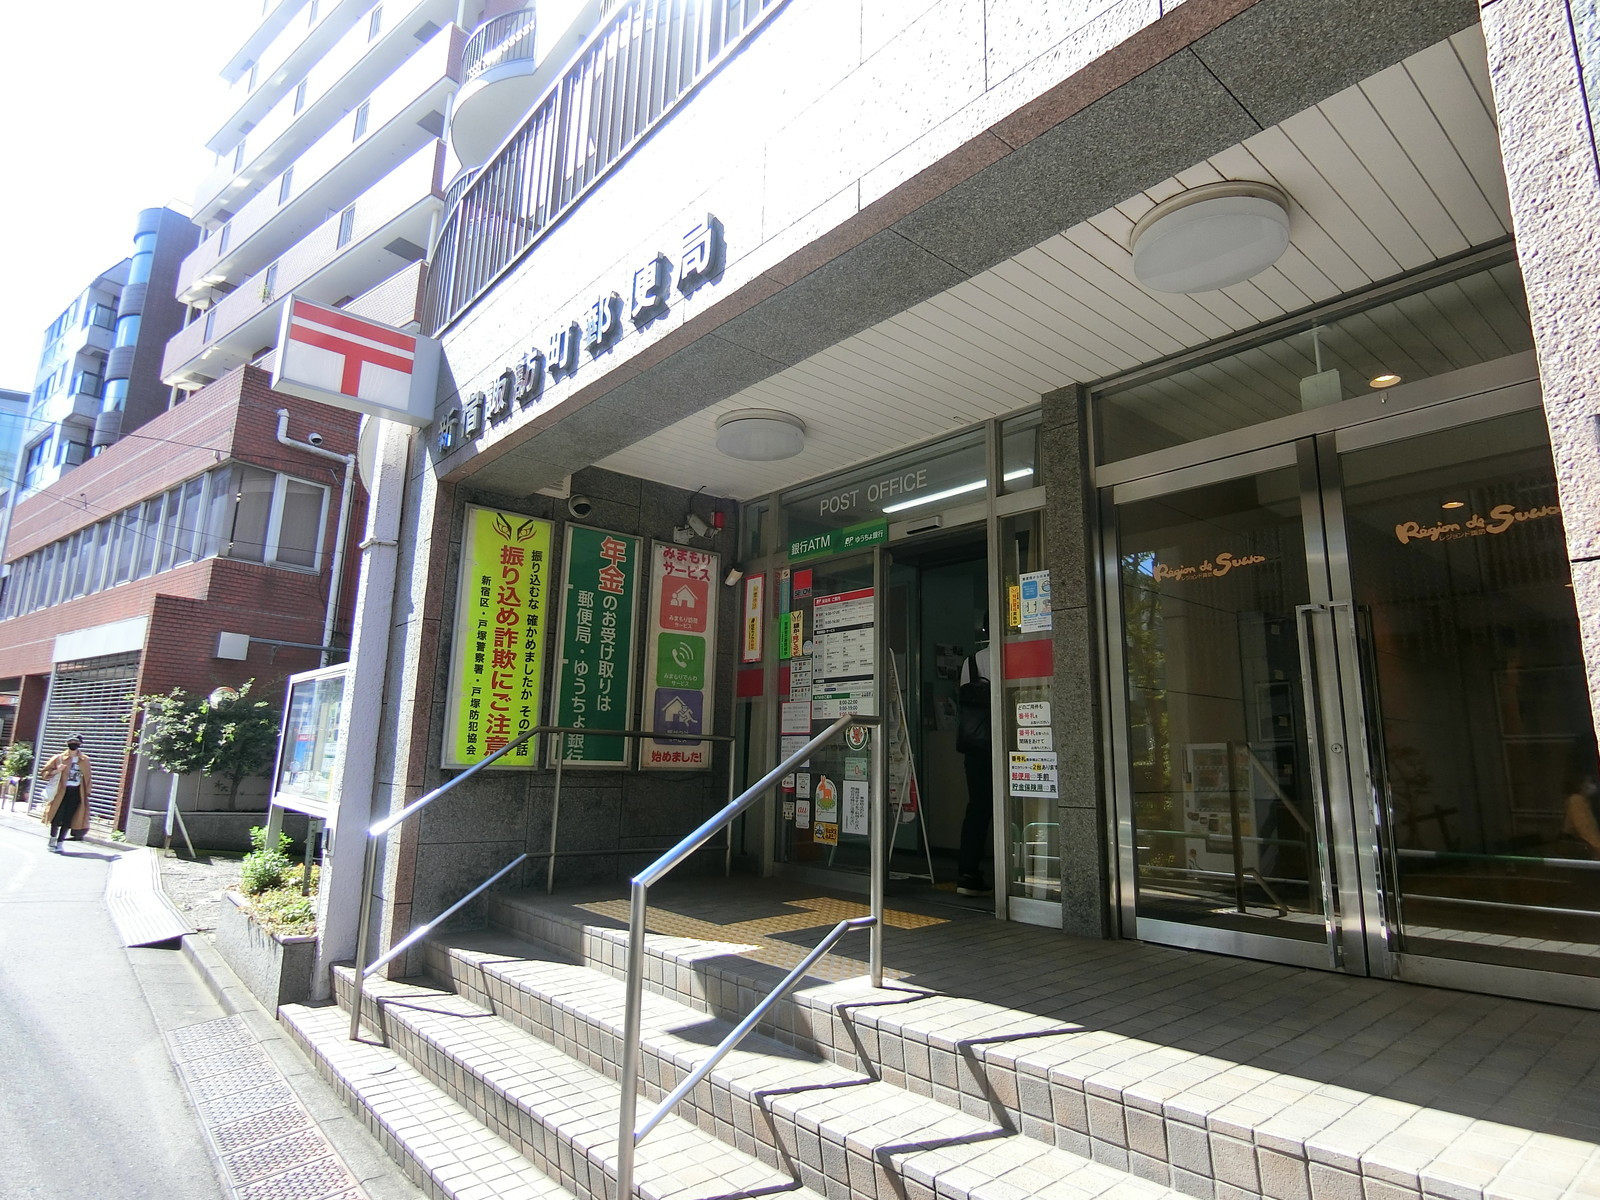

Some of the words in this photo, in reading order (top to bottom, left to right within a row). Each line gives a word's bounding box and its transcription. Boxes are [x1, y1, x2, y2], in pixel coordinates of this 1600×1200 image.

[820, 489, 859, 516] POST
[867, 469, 927, 502] OFFICE
[791, 534, 831, 556] 銀行ATM
[1465, 514, 1485, 529] de
[529, 550, 543, 610] 振り込むな
[663, 546, 711, 565] みまもり
[663, 561, 711, 581] サービス
[1200, 560, 1213, 571] de
[597, 536, 627, 711] 年金のお受け取りは
[466, 575, 492, 756] 新宿区・戸塚警察署・戸塚防犯協会
[484, 545, 525, 757] 振り込め詐欺にご注意
[521, 614, 539, 700] 確かめましたか
[567, 590, 595, 760] 郵便局・ゆうちょ銀行
